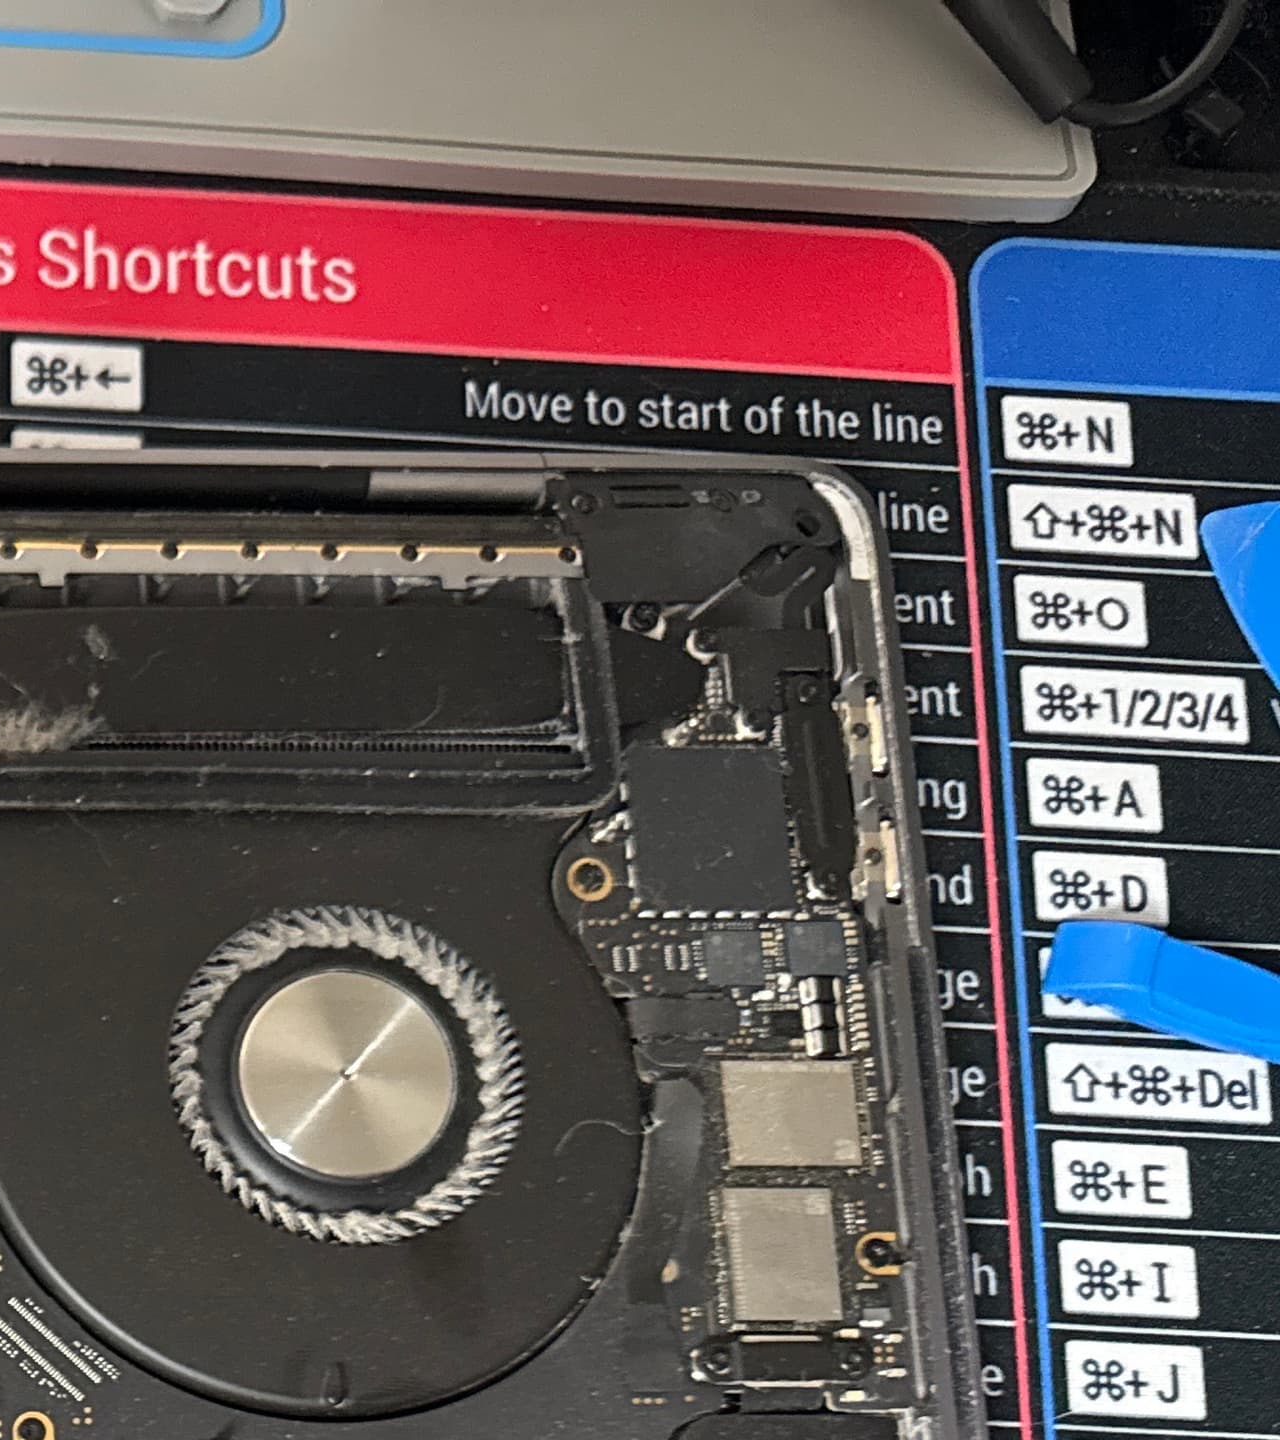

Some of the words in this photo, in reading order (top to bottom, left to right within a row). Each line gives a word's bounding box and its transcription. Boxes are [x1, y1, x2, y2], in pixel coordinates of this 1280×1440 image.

[39, 228, 357, 304] Shortcuts
[465, 380, 571, 423] Move
[584, 387, 625, 428] to
[639, 391, 731, 431] start
[744, 396, 784, 435] of
[797, 398, 859, 439] the
[872, 402, 944, 445] line
[880, 495, 949, 533] line
